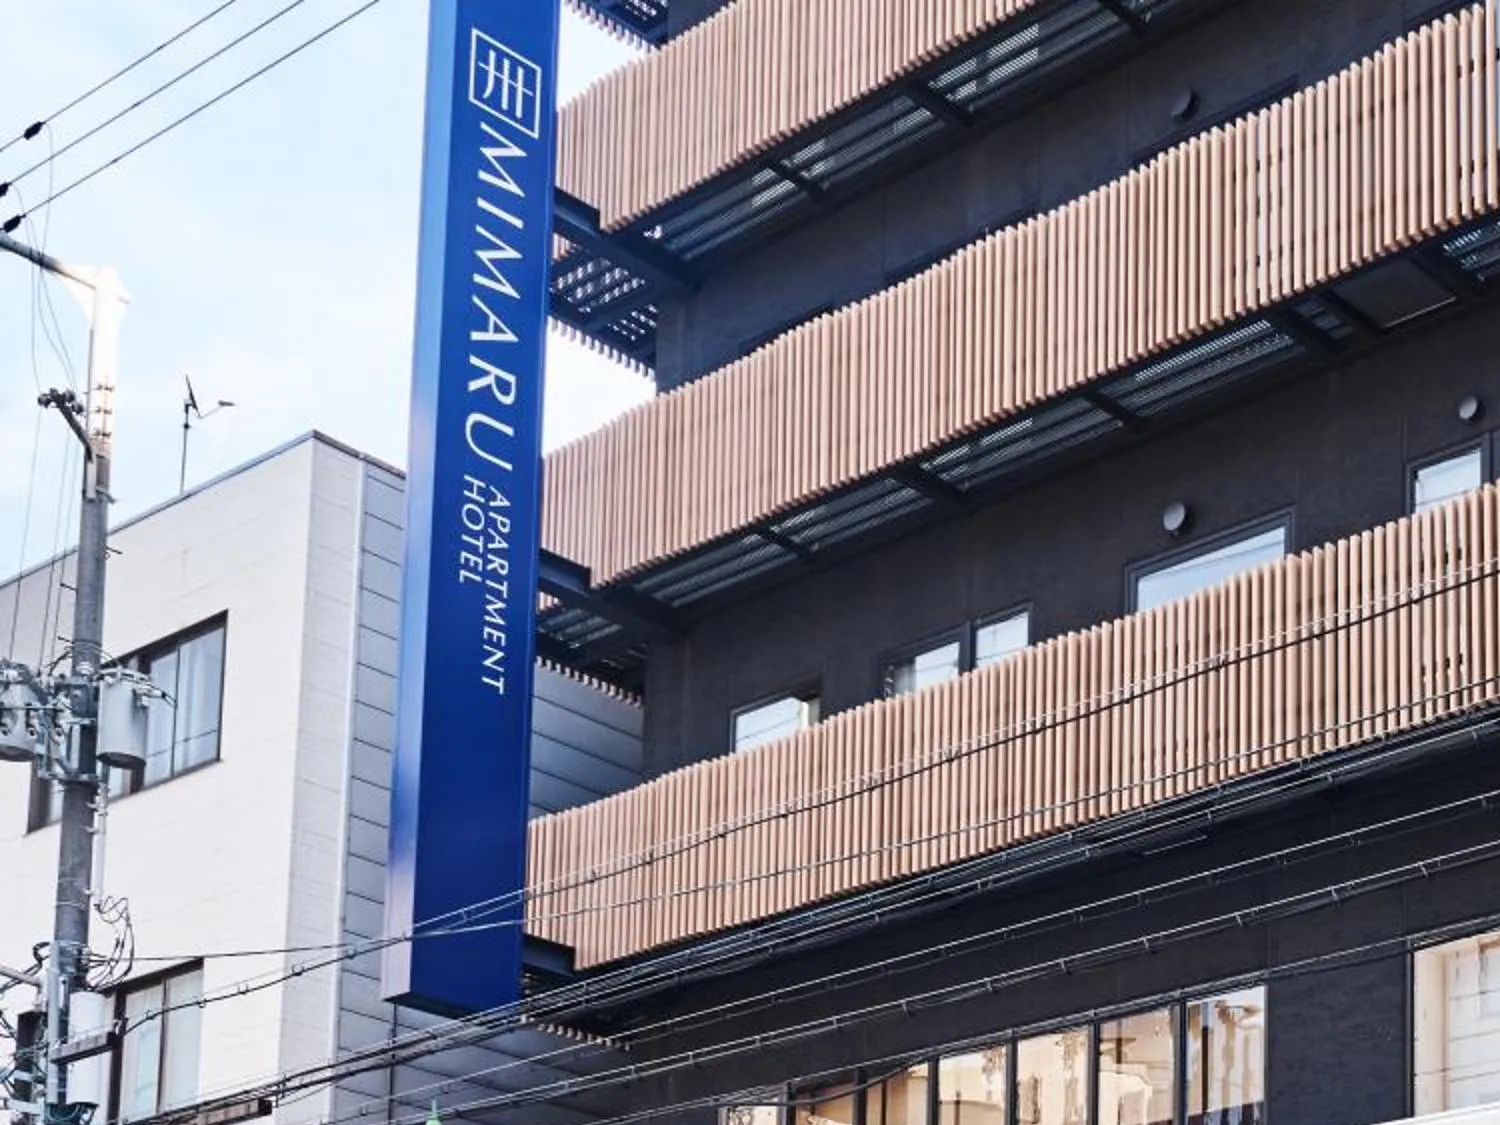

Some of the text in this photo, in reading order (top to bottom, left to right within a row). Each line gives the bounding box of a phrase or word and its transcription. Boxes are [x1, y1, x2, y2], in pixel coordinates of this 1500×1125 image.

[464, 120, 528, 472] MIMARU
[459, 474, 486, 583] HOTEL
[481, 485, 512, 695] APARTMENT
